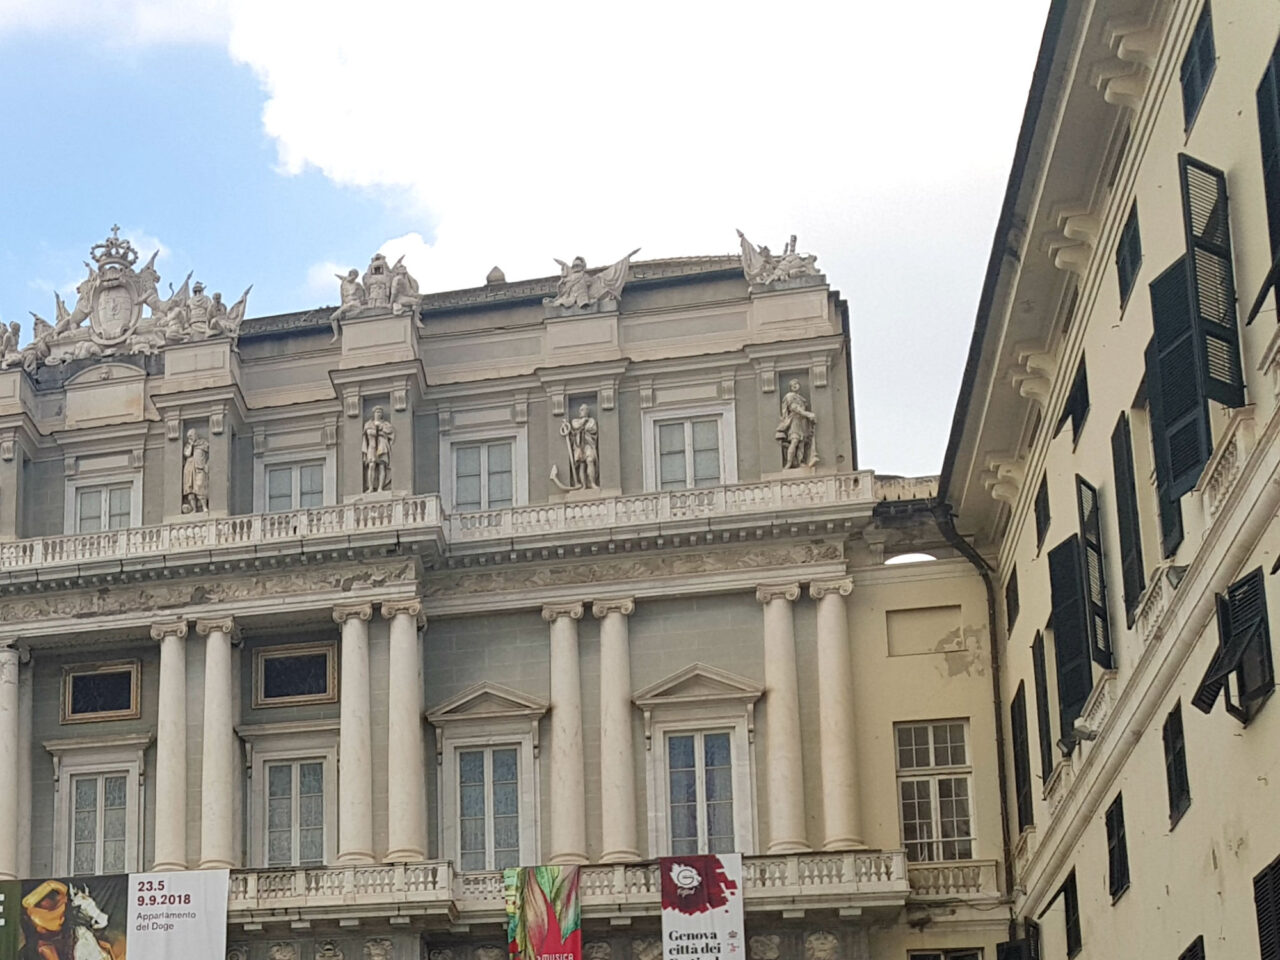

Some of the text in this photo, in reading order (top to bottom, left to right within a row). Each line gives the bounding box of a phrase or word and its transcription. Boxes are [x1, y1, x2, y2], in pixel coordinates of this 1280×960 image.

[137, 880, 165, 892] 23.5
[137, 894, 191, 907] 9.9.2018
[136, 911, 197, 922] Appartamento
[136, 922, 175, 931] del Doge
[668, 930, 718, 941] Genova
[668, 943, 699, 955] città
[701, 942, 722, 954] dei
